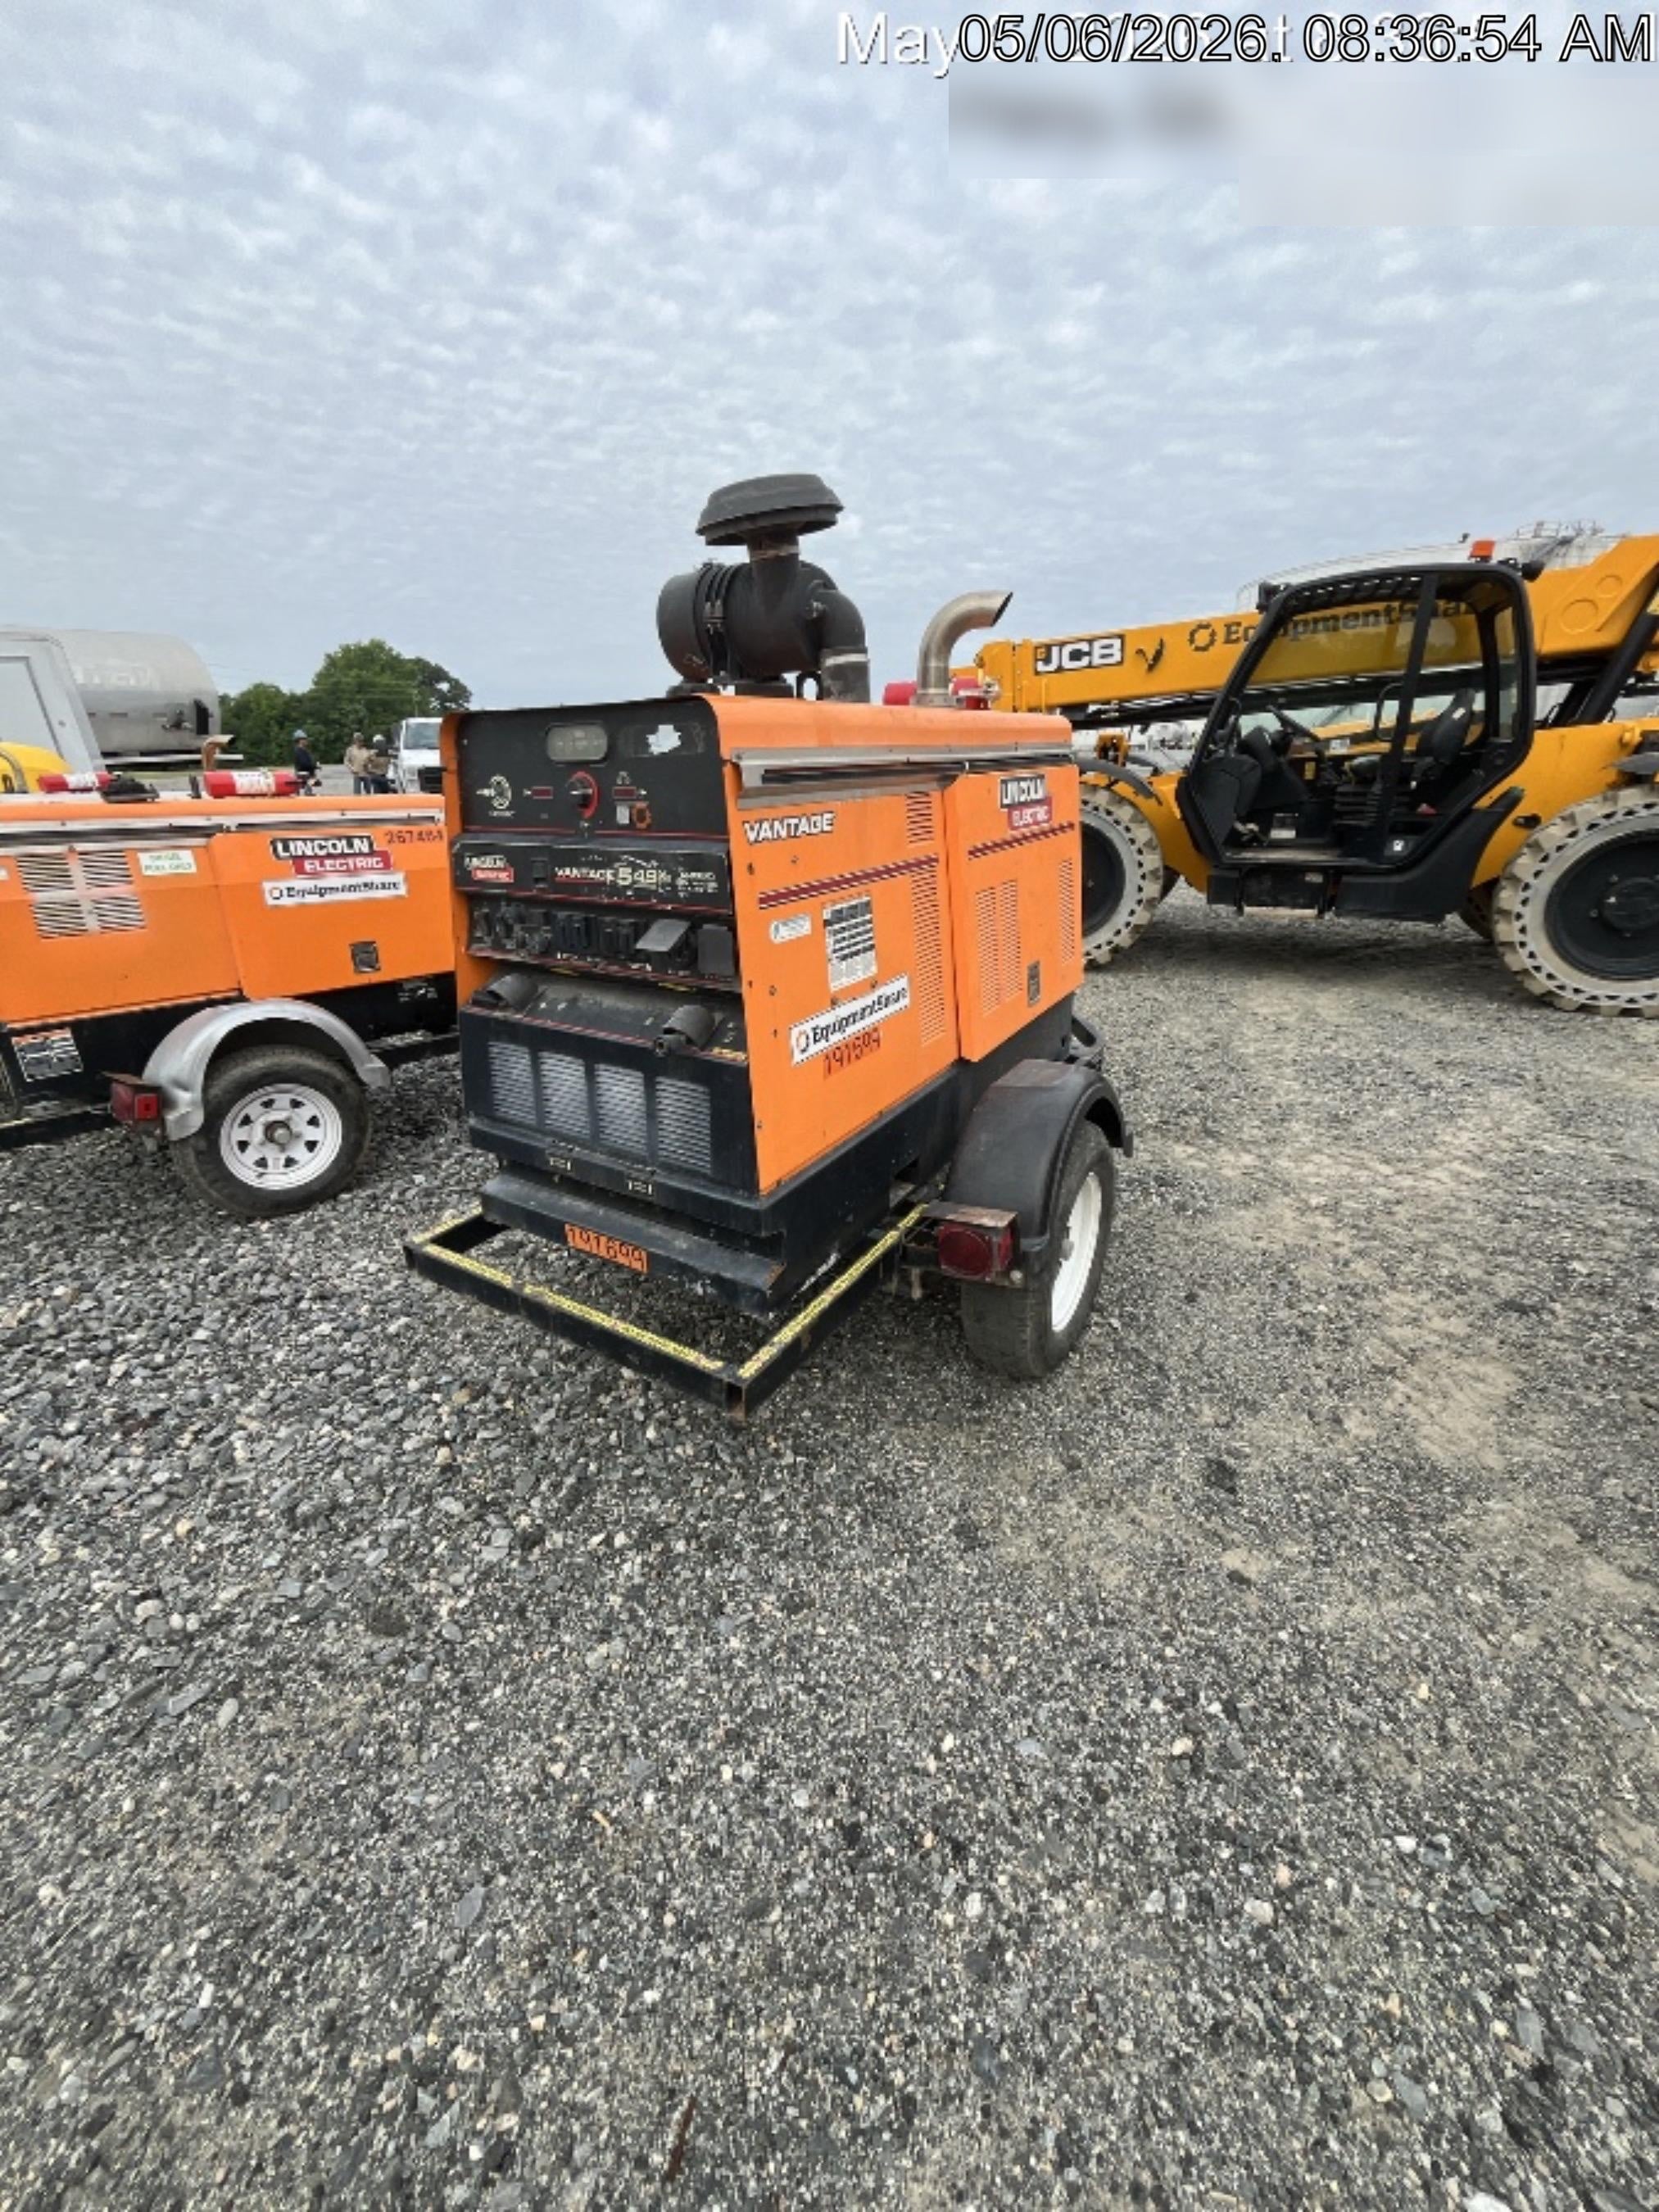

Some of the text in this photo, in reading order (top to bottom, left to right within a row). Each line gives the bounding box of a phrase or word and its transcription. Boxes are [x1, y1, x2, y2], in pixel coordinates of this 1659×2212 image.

[1036, 637, 1122, 673] JCB
[742, 811, 835, 844] VANTAGE
[275, 837, 370, 856] LINCOLN
[303, 857, 384, 873] ELECTRIC
